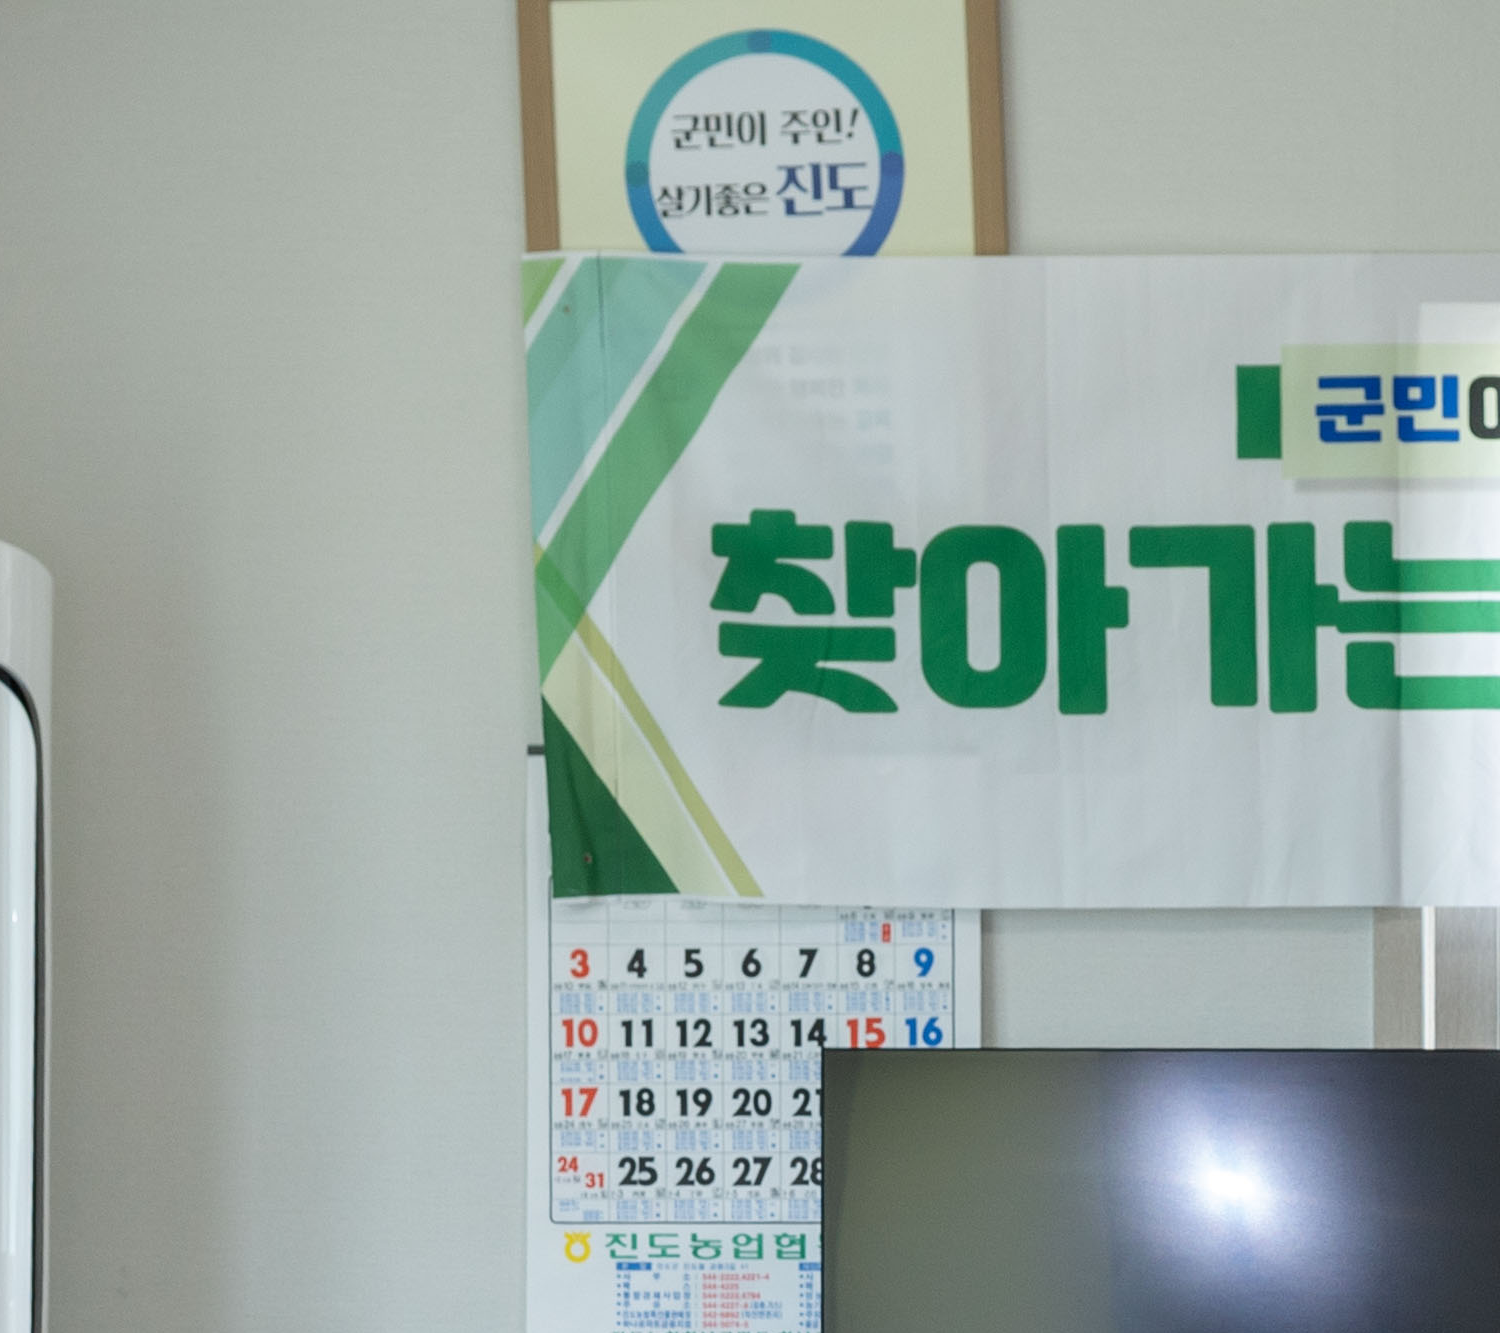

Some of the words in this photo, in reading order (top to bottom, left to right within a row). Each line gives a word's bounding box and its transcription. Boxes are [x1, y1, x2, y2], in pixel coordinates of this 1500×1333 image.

[674, 111, 767, 150] 군민이
[785, 102, 865, 145] 주인!
[655, 178, 770, 220] 살기좋은
[774, 160, 874, 219] 진도
[570, 948, 590, 979] 3
[626, 948, 648, 979] 4
[684, 948, 704, 979] 5
[741, 948, 762, 978] 6
[798, 948, 819, 979] 7
[856, 948, 876, 978] 8
[913, 947, 935, 978] 9
[561, 1018, 599, 1048] 10
[621, 1018, 653, 1048] 11
[675, 1018, 713, 1048] 12
[733, 1017, 770, 1048] 13
[790, 1017, 828, 1049] 14
[846, 1017, 886, 1048] 15
[905, 1016, 944, 1048] 16
[561, 1087, 599, 1117] 17
[619, 1087, 656, 1117] 18
[675, 1087, 713, 1117] 19
[732, 1087, 773, 1117] 20
[557, 1156, 579, 1173] 24
[585, 1172, 605, 1189] 31
[618, 1156, 659, 1187] 25
[675, 1156, 716, 1187] 26
[732, 1156, 773, 1187] 27
[604, 1232, 821, 1260] 진도농업협
